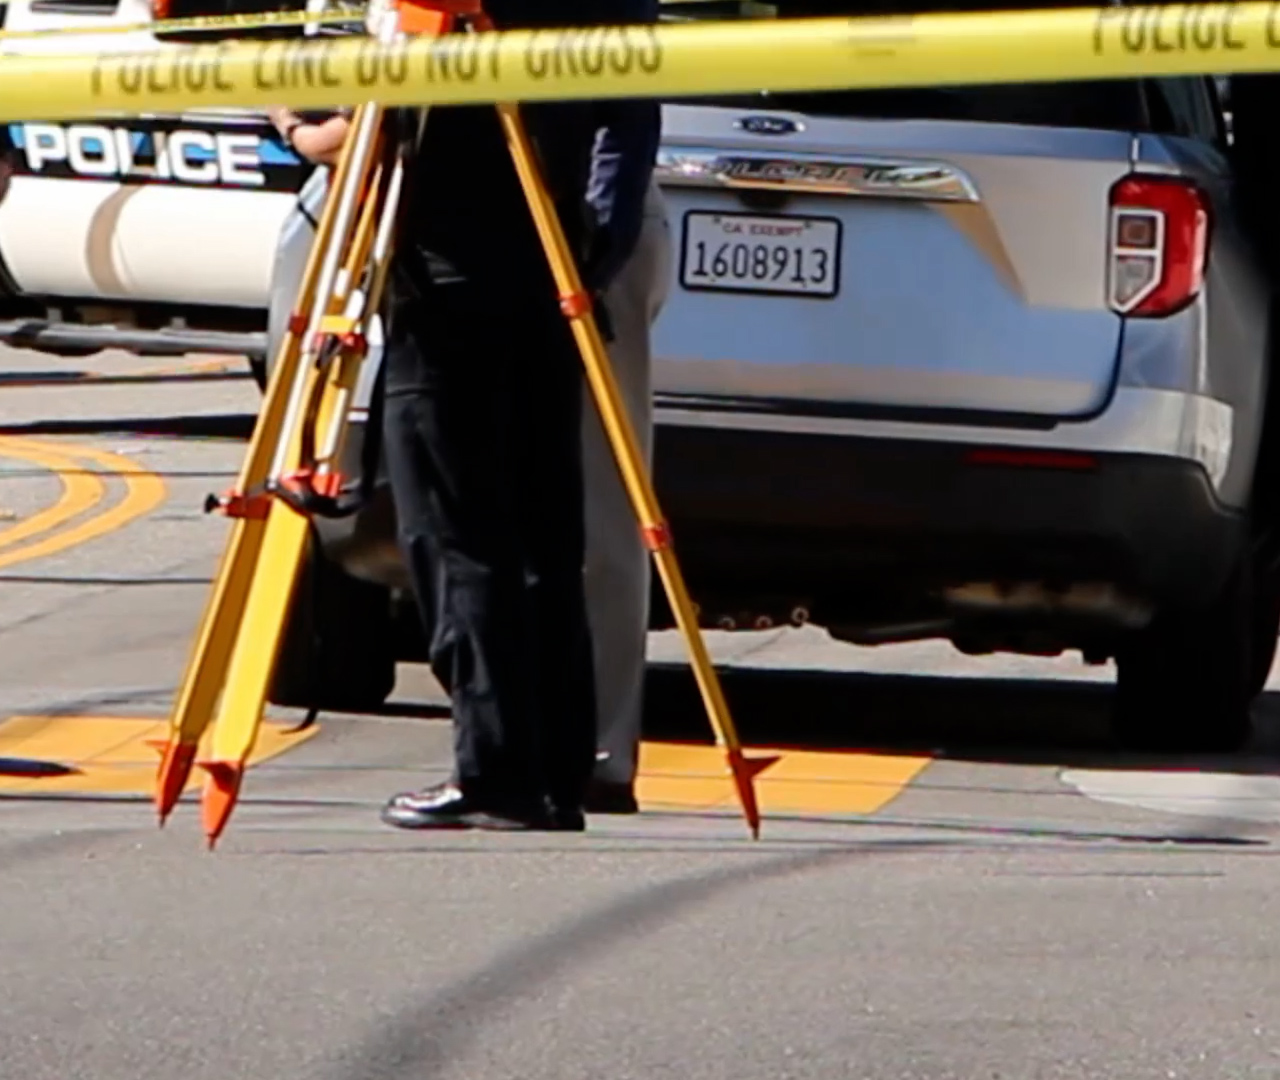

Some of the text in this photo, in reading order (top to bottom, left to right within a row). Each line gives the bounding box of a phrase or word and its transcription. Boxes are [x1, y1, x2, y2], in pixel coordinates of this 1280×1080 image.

[1092, 1, 1245, 55] POLICE
[90, 24, 663, 95] POLICE LINE DO NOT CROSS
[23, 123, 266, 186] POLICE
[691, 241, 828, 283] 1608913
